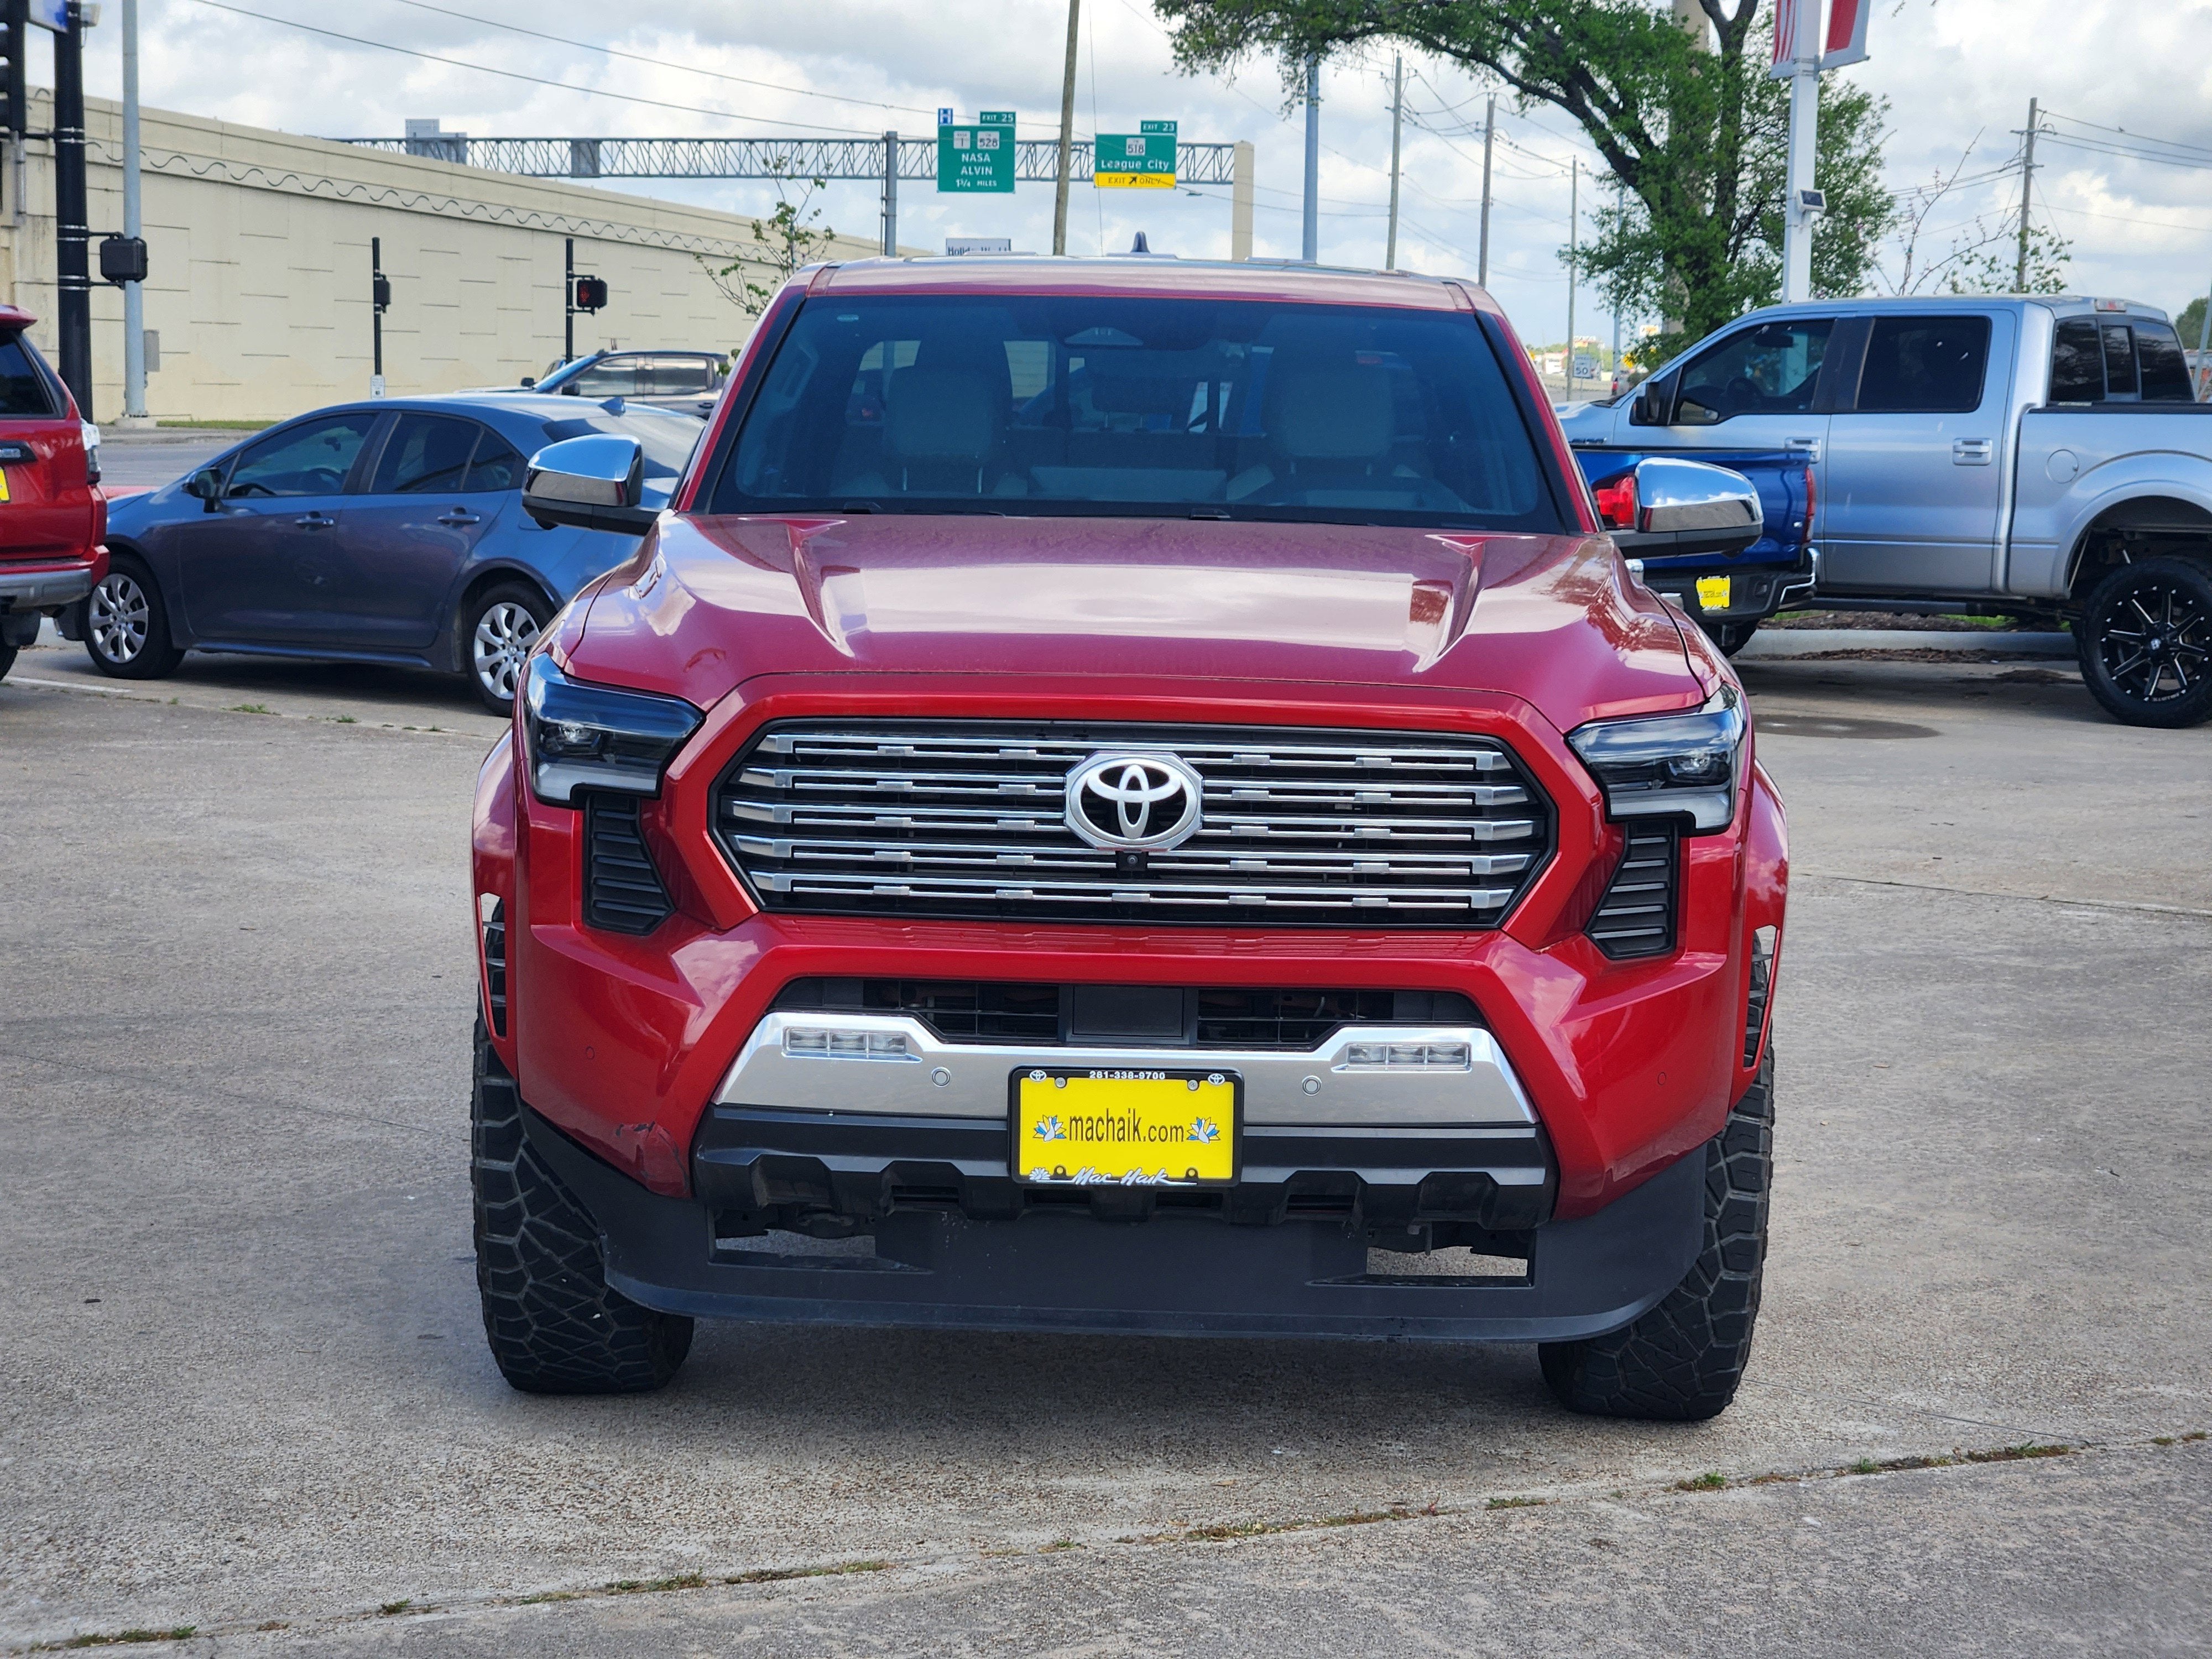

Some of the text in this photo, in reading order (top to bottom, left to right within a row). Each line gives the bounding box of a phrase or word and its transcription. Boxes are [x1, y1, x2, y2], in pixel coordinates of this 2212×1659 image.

[940, 108, 952, 124] H
[1001, 113, 1014, 122] 25
[1162, 123, 1175, 132] 23
[979, 138, 998, 148] 528
[1127, 144, 1144, 154] 518
[961, 153, 990, 163] NASA
[1100, 159, 1170, 171] League City
[961, 165, 993, 176] ALVIN
[1576, 367, 1588, 375] 50
[1089, 1070, 1166, 1080] 281-338-9700
[1069, 1107, 1184, 1142] machaik.com
[1072, 1166, 1171, 1187] Mac Haik
